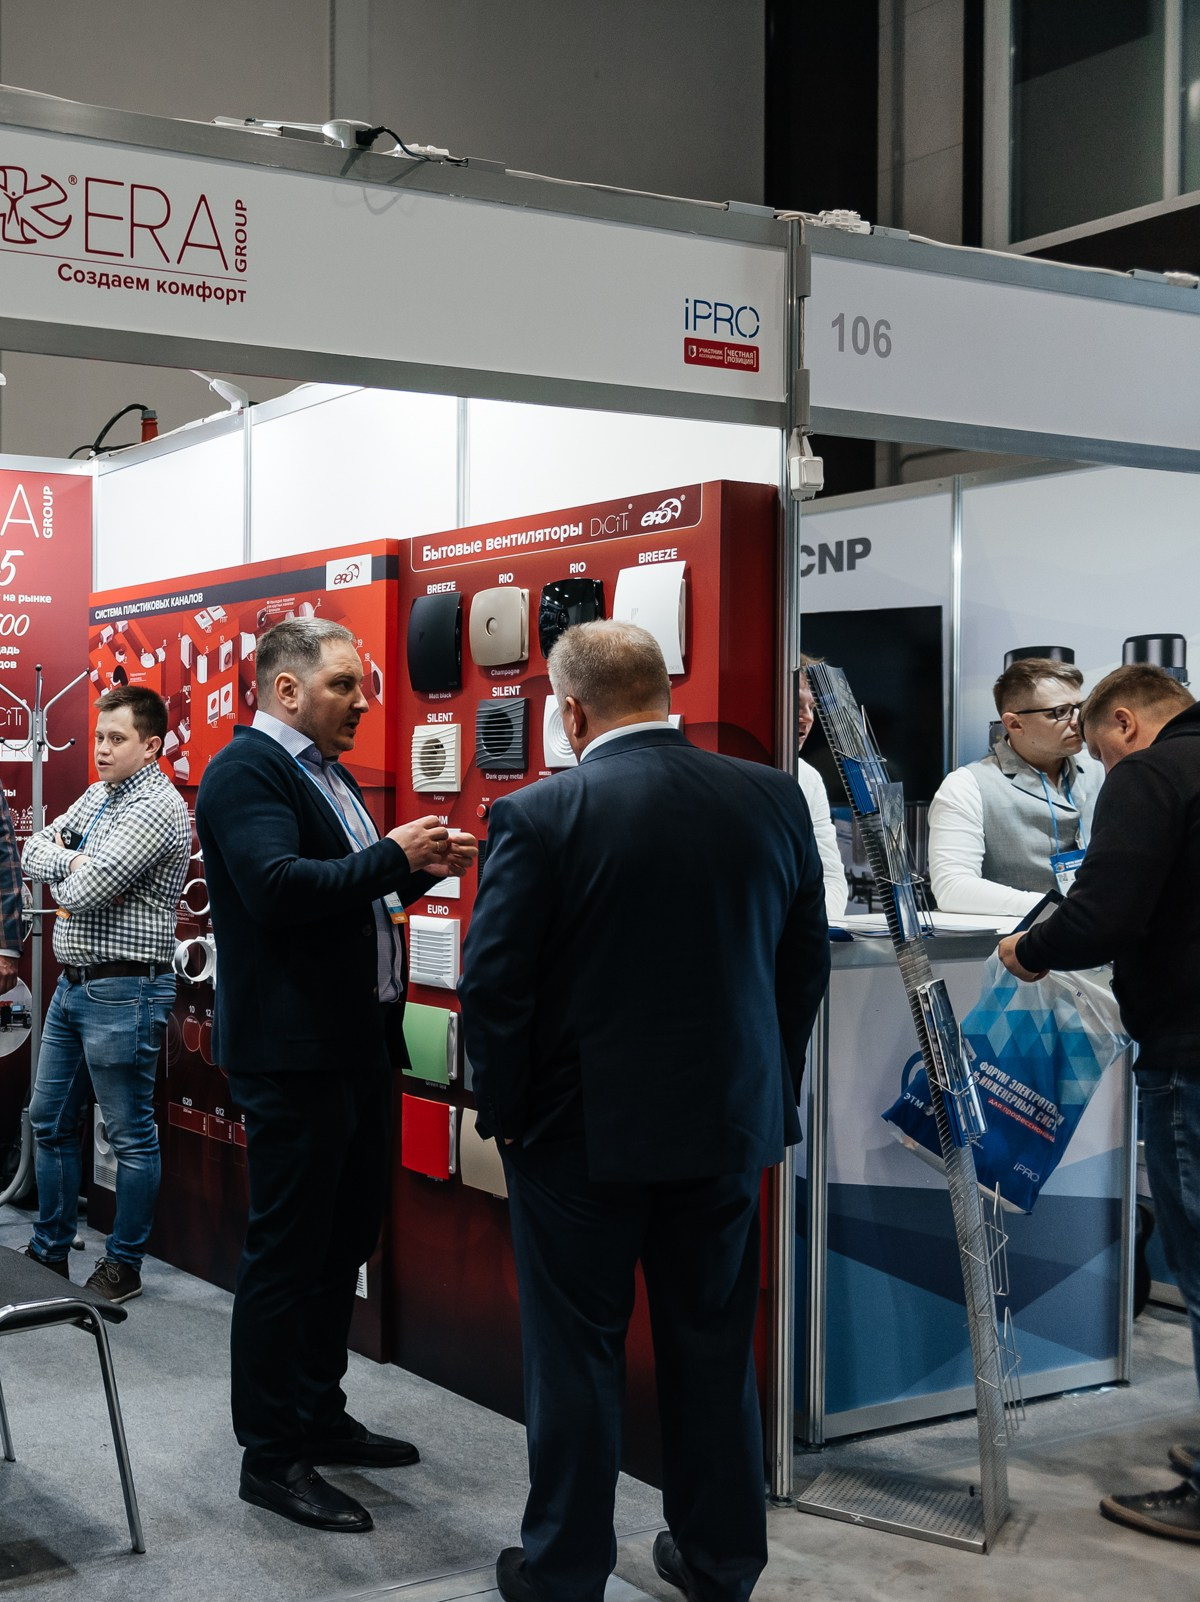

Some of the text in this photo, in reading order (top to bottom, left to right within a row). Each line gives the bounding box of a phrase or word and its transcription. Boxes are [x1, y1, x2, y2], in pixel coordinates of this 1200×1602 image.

[84, 177, 247, 273] ERA GROUP
[57, 263, 247, 306] Создаем комфорт
[684, 298, 760, 339] iPRO
[831, 312, 892, 359] 106
[727, 349, 754, 359] ЧЕСТНАЯ
[42, 485, 54, 539] GROUP
[422, 522, 583, 563] Бытовые вентиляторы
[638, 548, 678, 564] BREEZE
[800, 537, 872, 577] CNP
[569, 562, 587, 574] RIO
[498, 572, 514, 584] RIO
[427, 581, 457, 595] BREEZE
[3, 593, 16, 603] на
[18, 594, 52, 604] рынке
[94, 592, 204, 620] СИСТЕМА ПЛАСТИКОВЫХ КАНАЛОВ
[491, 668, 520, 677] Champagne
[492, 685, 521, 697] SILENT
[427, 712, 454, 723] SILENT
[485, 772, 498, 780] Dark
[498, 773, 509, 781] gray
[433, 794, 445, 802] Ivory
[427, 904, 449, 915] EURO
[189, 1005, 196, 1014] 10
[979, 1061, 1011, 1085] ФОРУМ
[182, 1096, 193, 1107] 620
[903, 1092, 925, 1109] ЭТМ
[978, 1076, 1037, 1118] ИНЖЕНЕРНЫХ
[215, 1106, 225, 1117] 612
